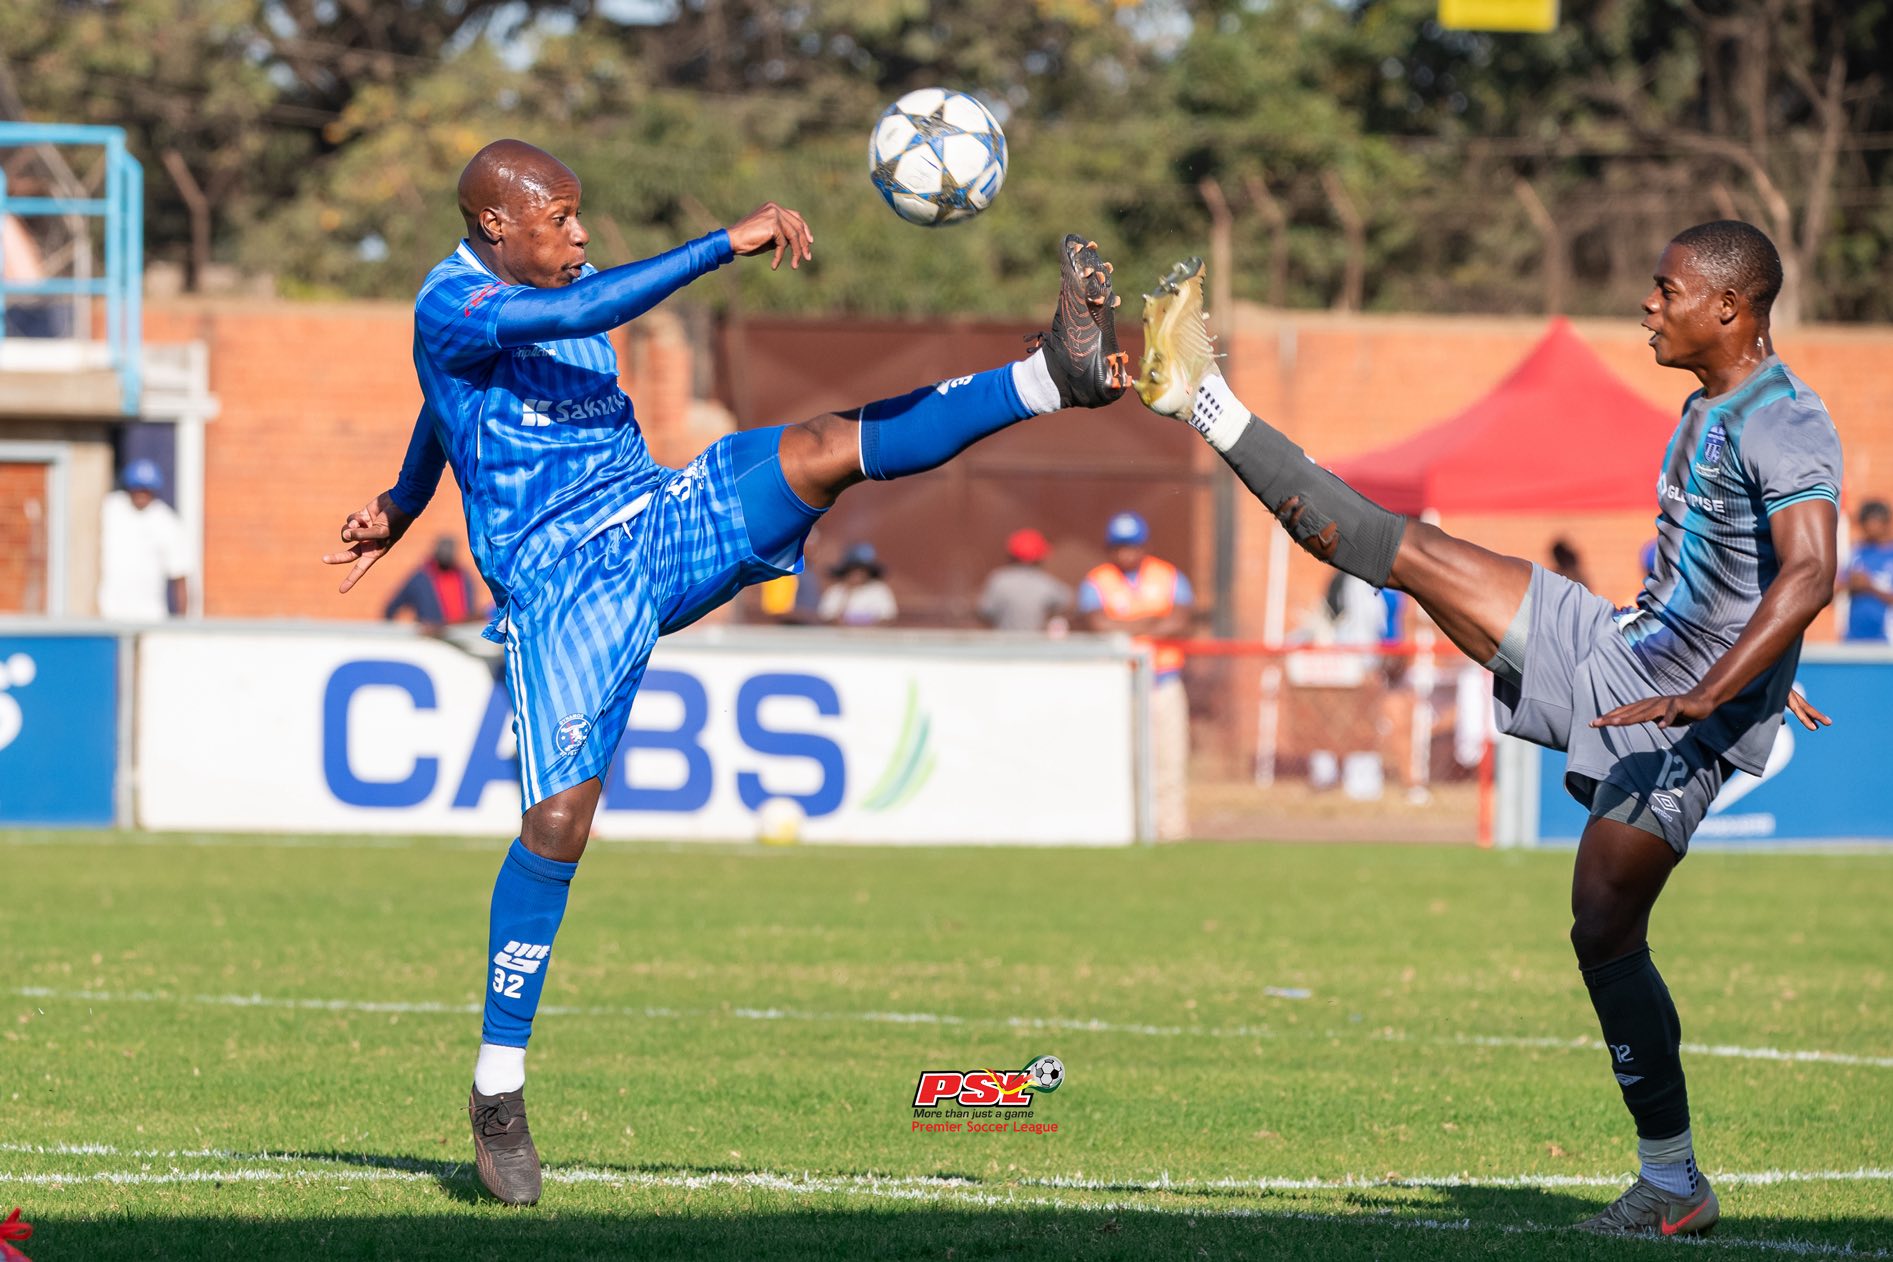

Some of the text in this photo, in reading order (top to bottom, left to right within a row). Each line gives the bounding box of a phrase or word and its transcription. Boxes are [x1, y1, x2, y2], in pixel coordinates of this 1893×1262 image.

[1656, 745, 1688, 798] 12
[492, 967, 525, 999] 32
[1610, 1044, 1634, 1064] 12
